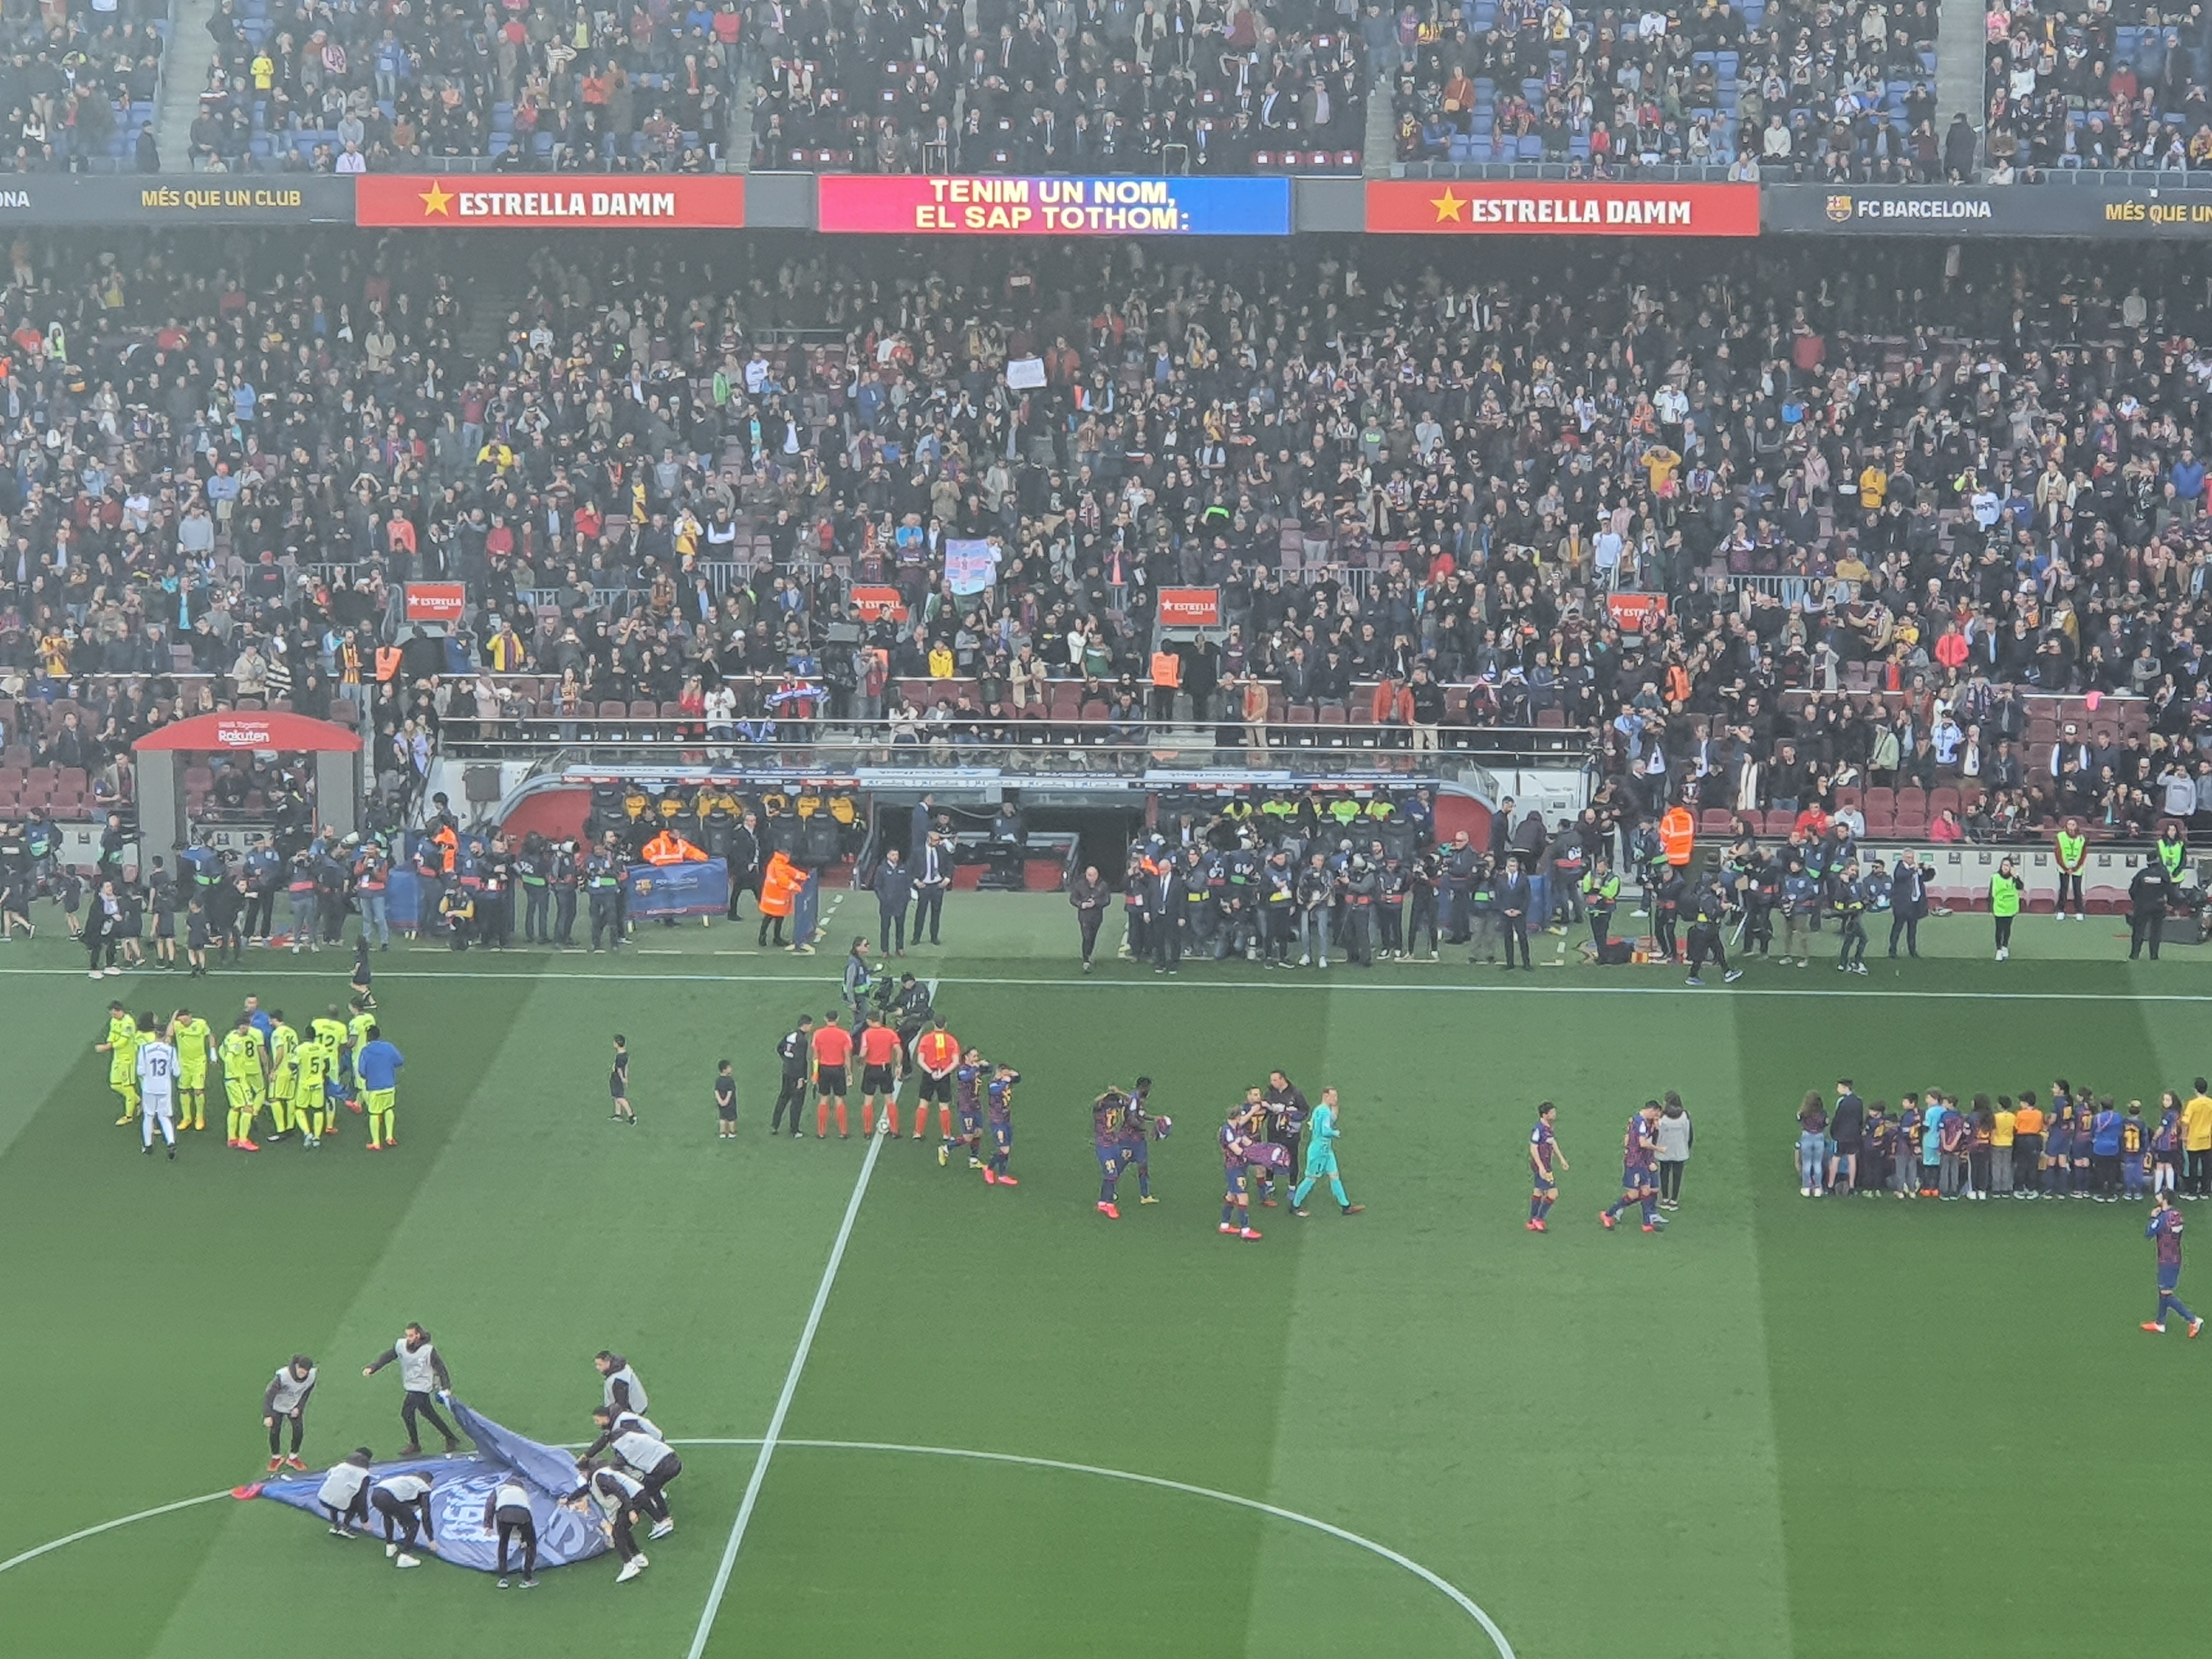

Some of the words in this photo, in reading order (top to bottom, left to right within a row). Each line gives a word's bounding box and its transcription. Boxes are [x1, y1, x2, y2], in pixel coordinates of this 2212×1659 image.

[0, 191, 31, 207] NA
[142, 185, 180, 207] MÉS
[184, 190, 220, 210] QUE
[225, 190, 251, 207] UN
[255, 190, 301, 207] CLUB
[459, 192, 586, 216] ESTRELLA
[591, 192, 675, 217] DAMM
[930, 179, 1029, 203] TENIM
[1039, 180, 1084, 203] UN
[1094, 181, 1176, 207] NOM,
[916, 205, 956, 228] EL
[964, 206, 1032, 229] SAP
[1042, 207, 1189, 230] TOTHOM:
[1471, 199, 1601, 223] ESTRELLA
[1606, 199, 1691, 224] DAMM
[1857, 200, 1880, 218] FC
[1882, 200, 1992, 218] BARCELONA
[2105, 199, 2146, 221] MÉS
[2149, 204, 2187, 225] QUE
[245, 1040, 254, 1058] 8
[149, 1057, 167, 1076] 13
[310, 1057, 320, 1074] 5
